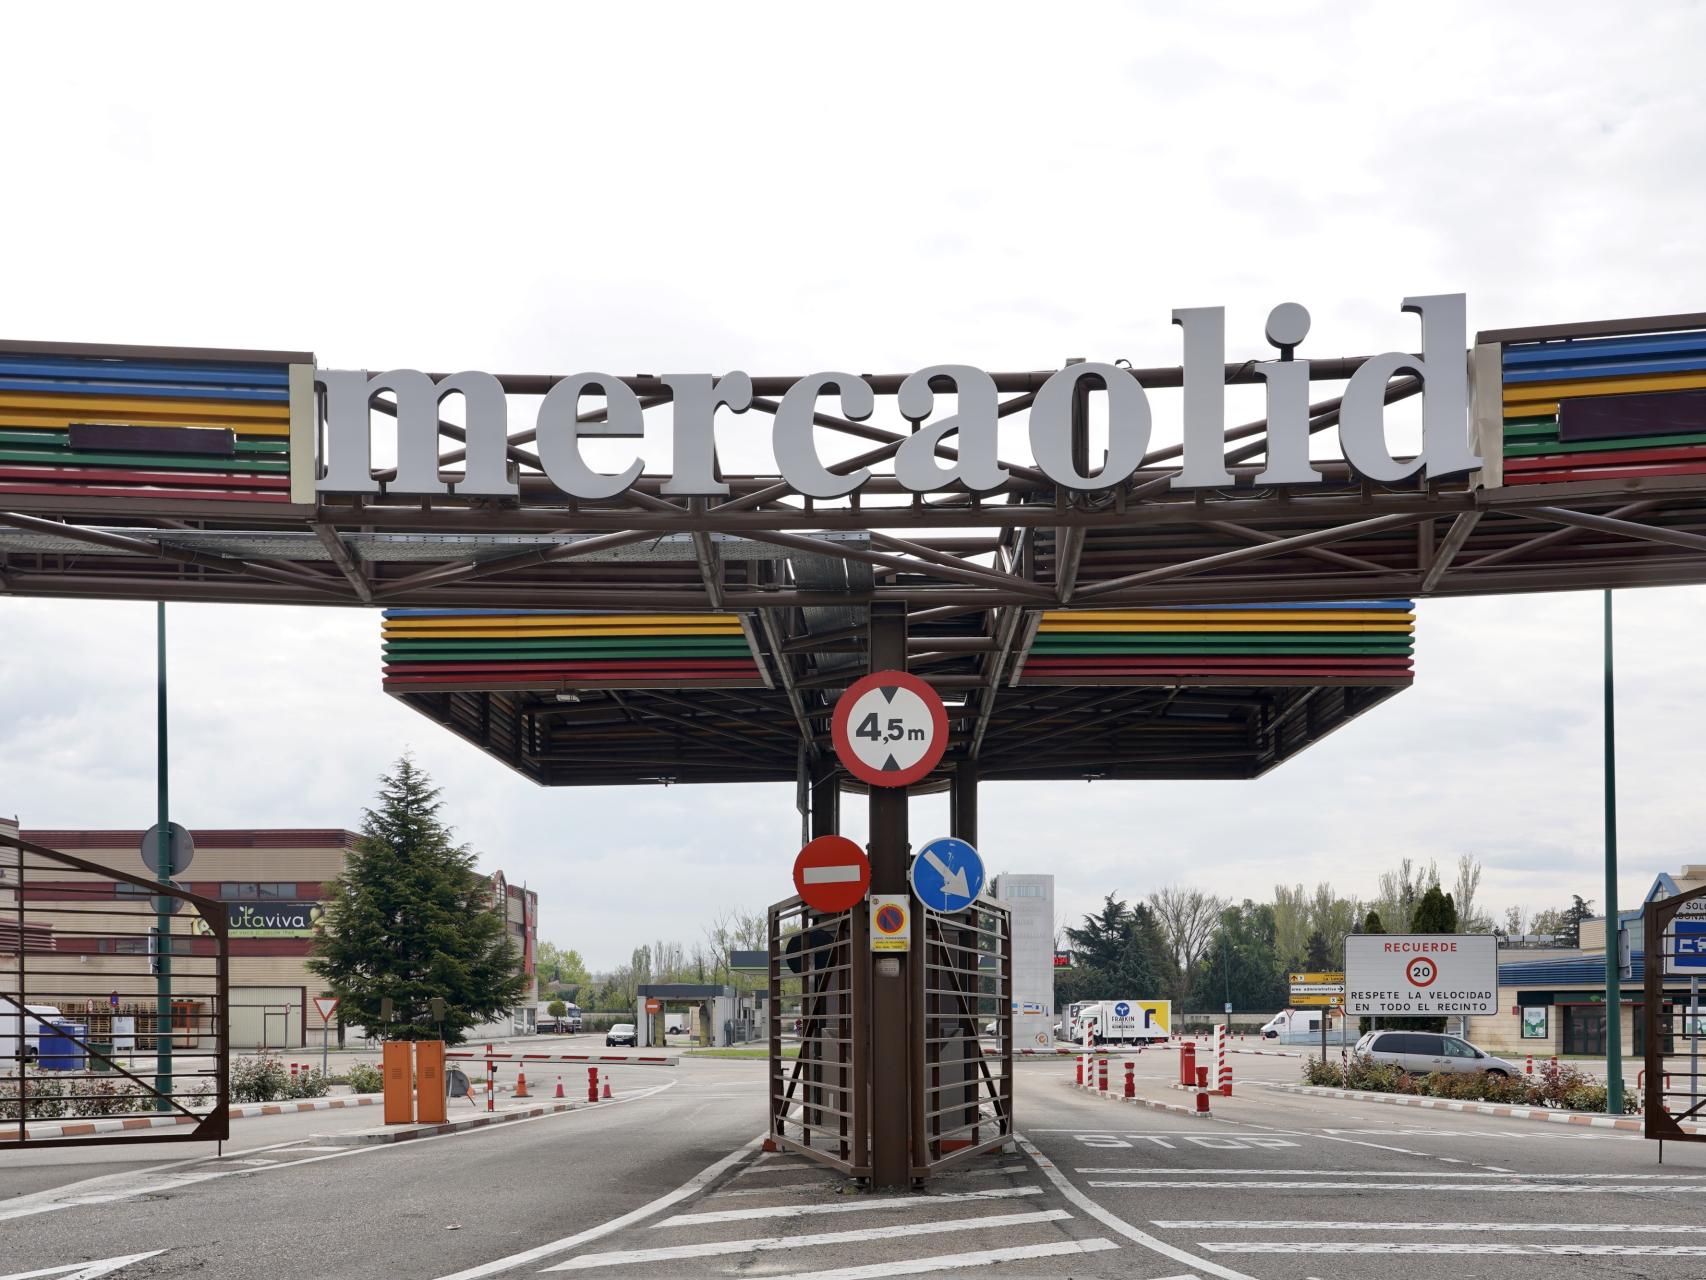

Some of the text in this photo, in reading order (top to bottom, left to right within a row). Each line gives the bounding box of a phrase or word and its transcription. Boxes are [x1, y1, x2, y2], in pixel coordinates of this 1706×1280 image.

[315, 293, 1484, 500] mercaolid
[1384, 943, 1457, 953] RECUERDE
[1413, 967, 1430, 977] 20
[1351, 991, 1492, 999] RESPETE LA VELOCIDAD
[1355, 1003, 1487, 1011] EN TODO EL RECINTO
[1072, 1134, 1301, 1150] STOP
